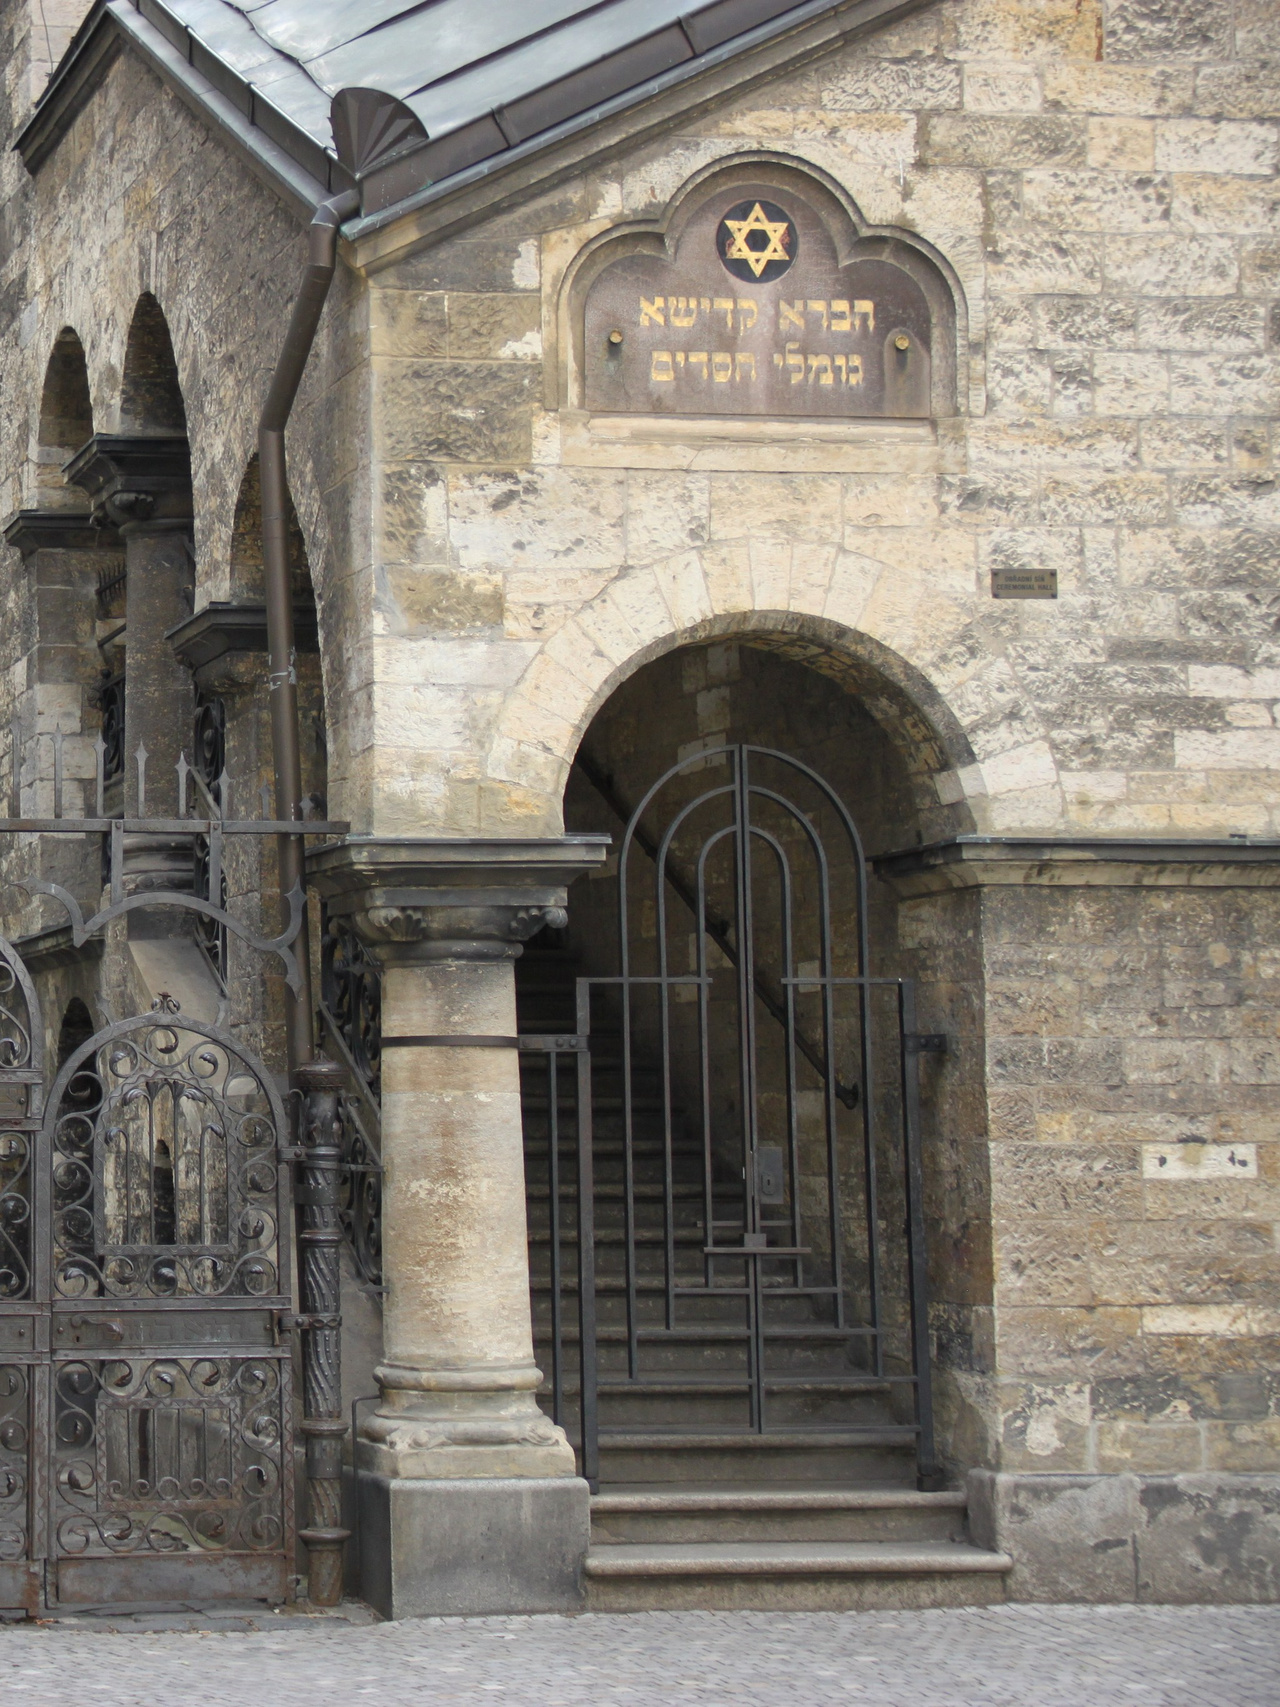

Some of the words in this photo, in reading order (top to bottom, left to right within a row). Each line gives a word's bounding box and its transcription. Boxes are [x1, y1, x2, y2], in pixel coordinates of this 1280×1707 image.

[639, 296, 758, 336] קדישא
[779, 299, 876, 334] חברא
[651, 350, 756, 384] חסדים
[773, 341, 864, 384] גומלי
